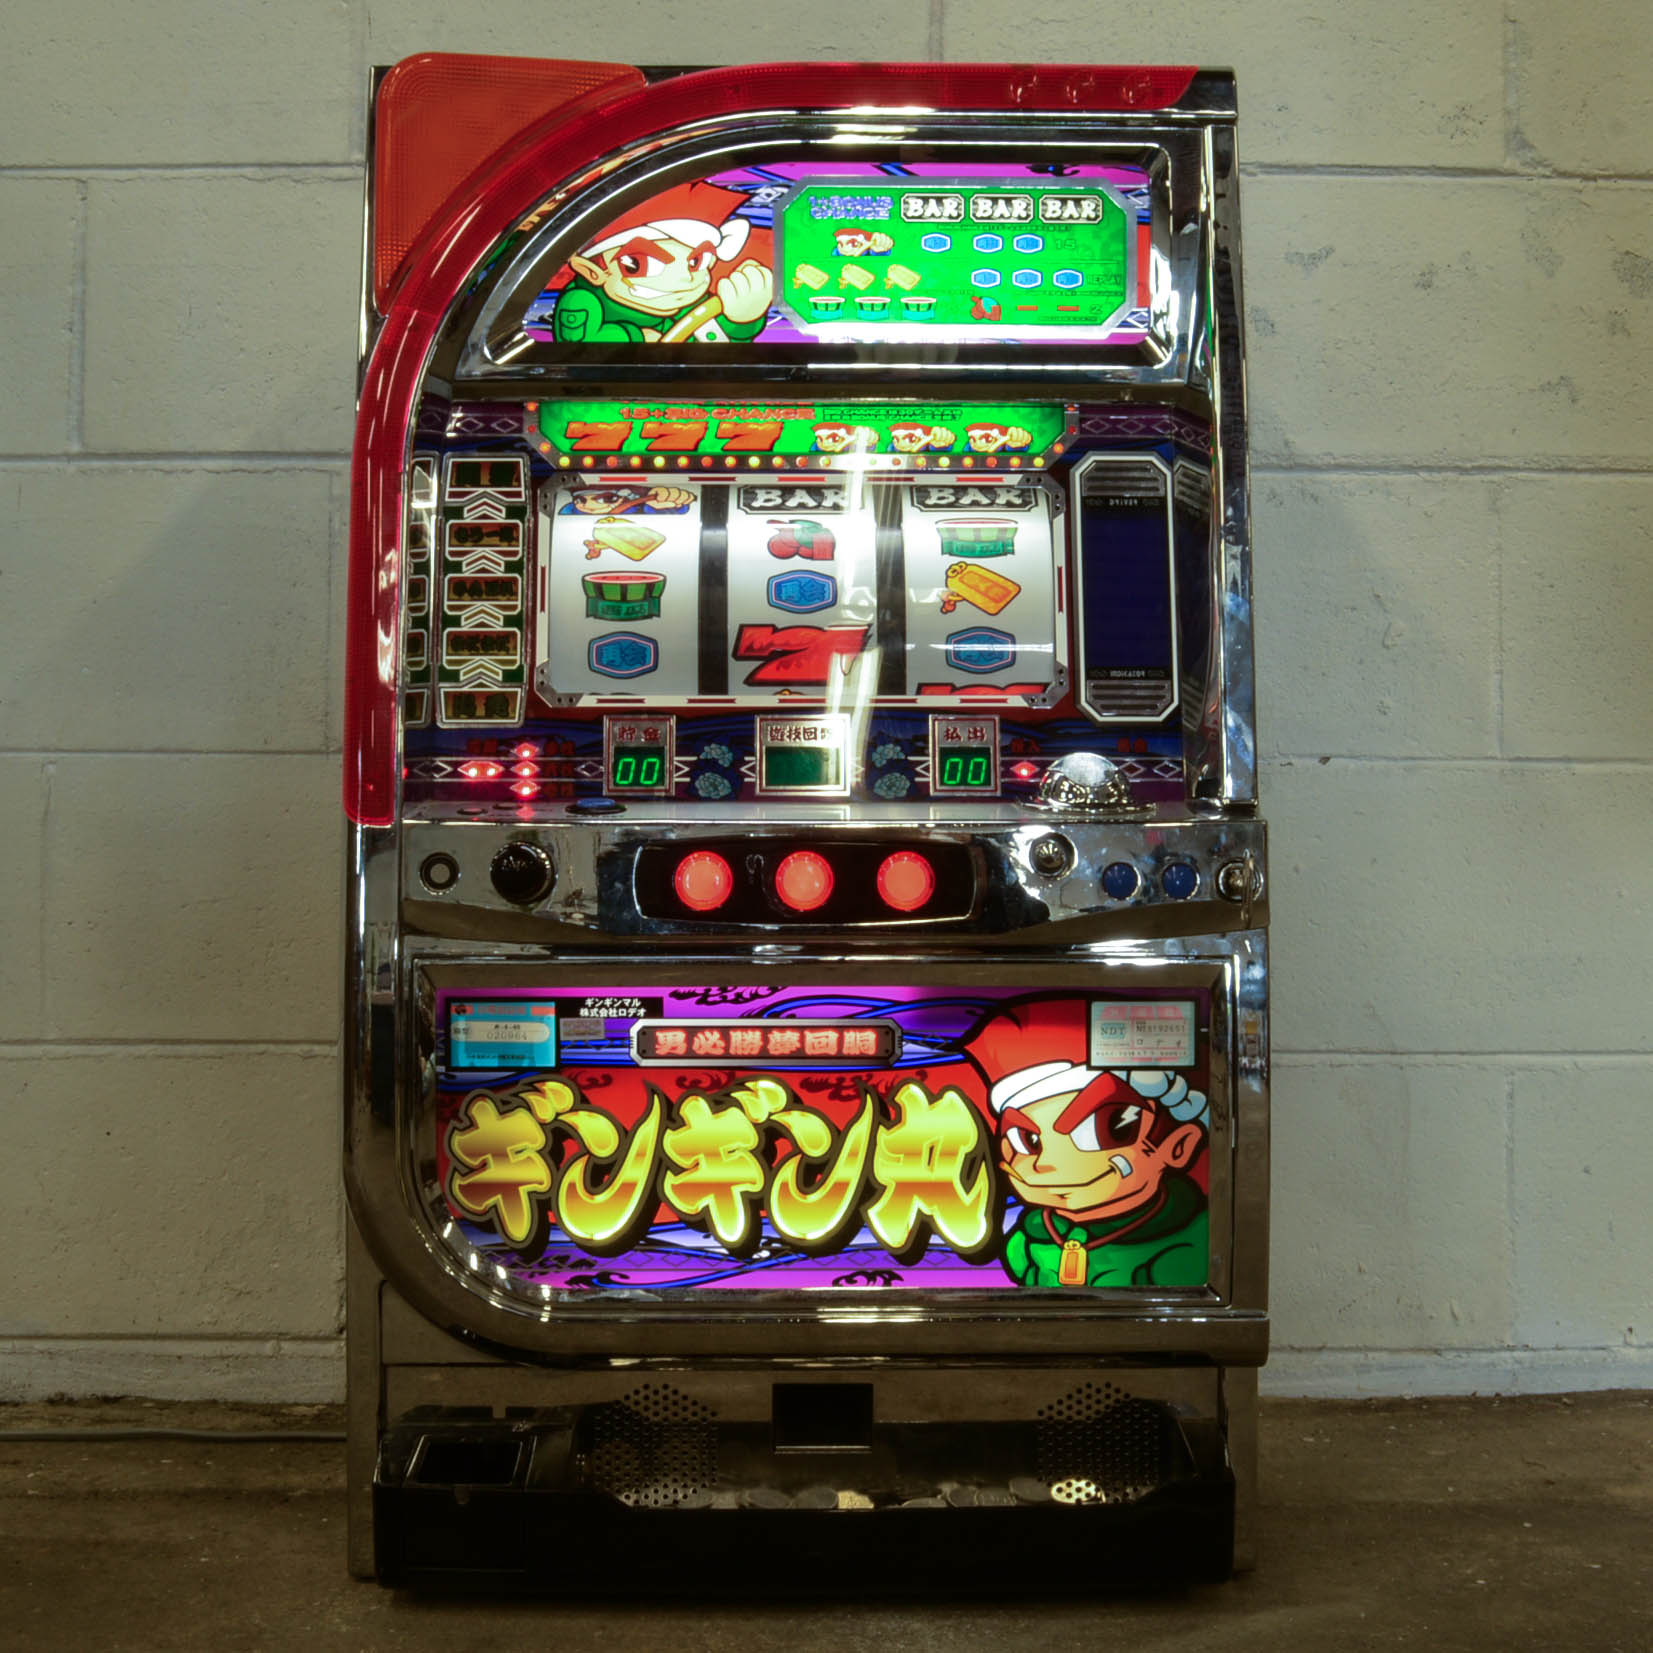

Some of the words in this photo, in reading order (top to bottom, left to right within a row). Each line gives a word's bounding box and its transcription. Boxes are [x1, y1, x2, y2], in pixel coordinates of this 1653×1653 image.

[906, 196, 960, 218] BAR
[975, 197, 1029, 219] BAR
[1044, 198, 1098, 220] BAR
[710, 407, 816, 421] CHANCE
[750, 487, 848, 508] BAR
[924, 487, 1023, 505] BAR
[615, 757, 660, 785] 00
[943, 757, 987, 785] 00
[579, 1007, 647, 1018] 株式会社ロデオ
[585, 997, 642, 1007] ギンギンマル
[655, 1029, 877, 1056] 男必勝夢回胴
[449, 1077, 992, 1250] ギンギン丸
